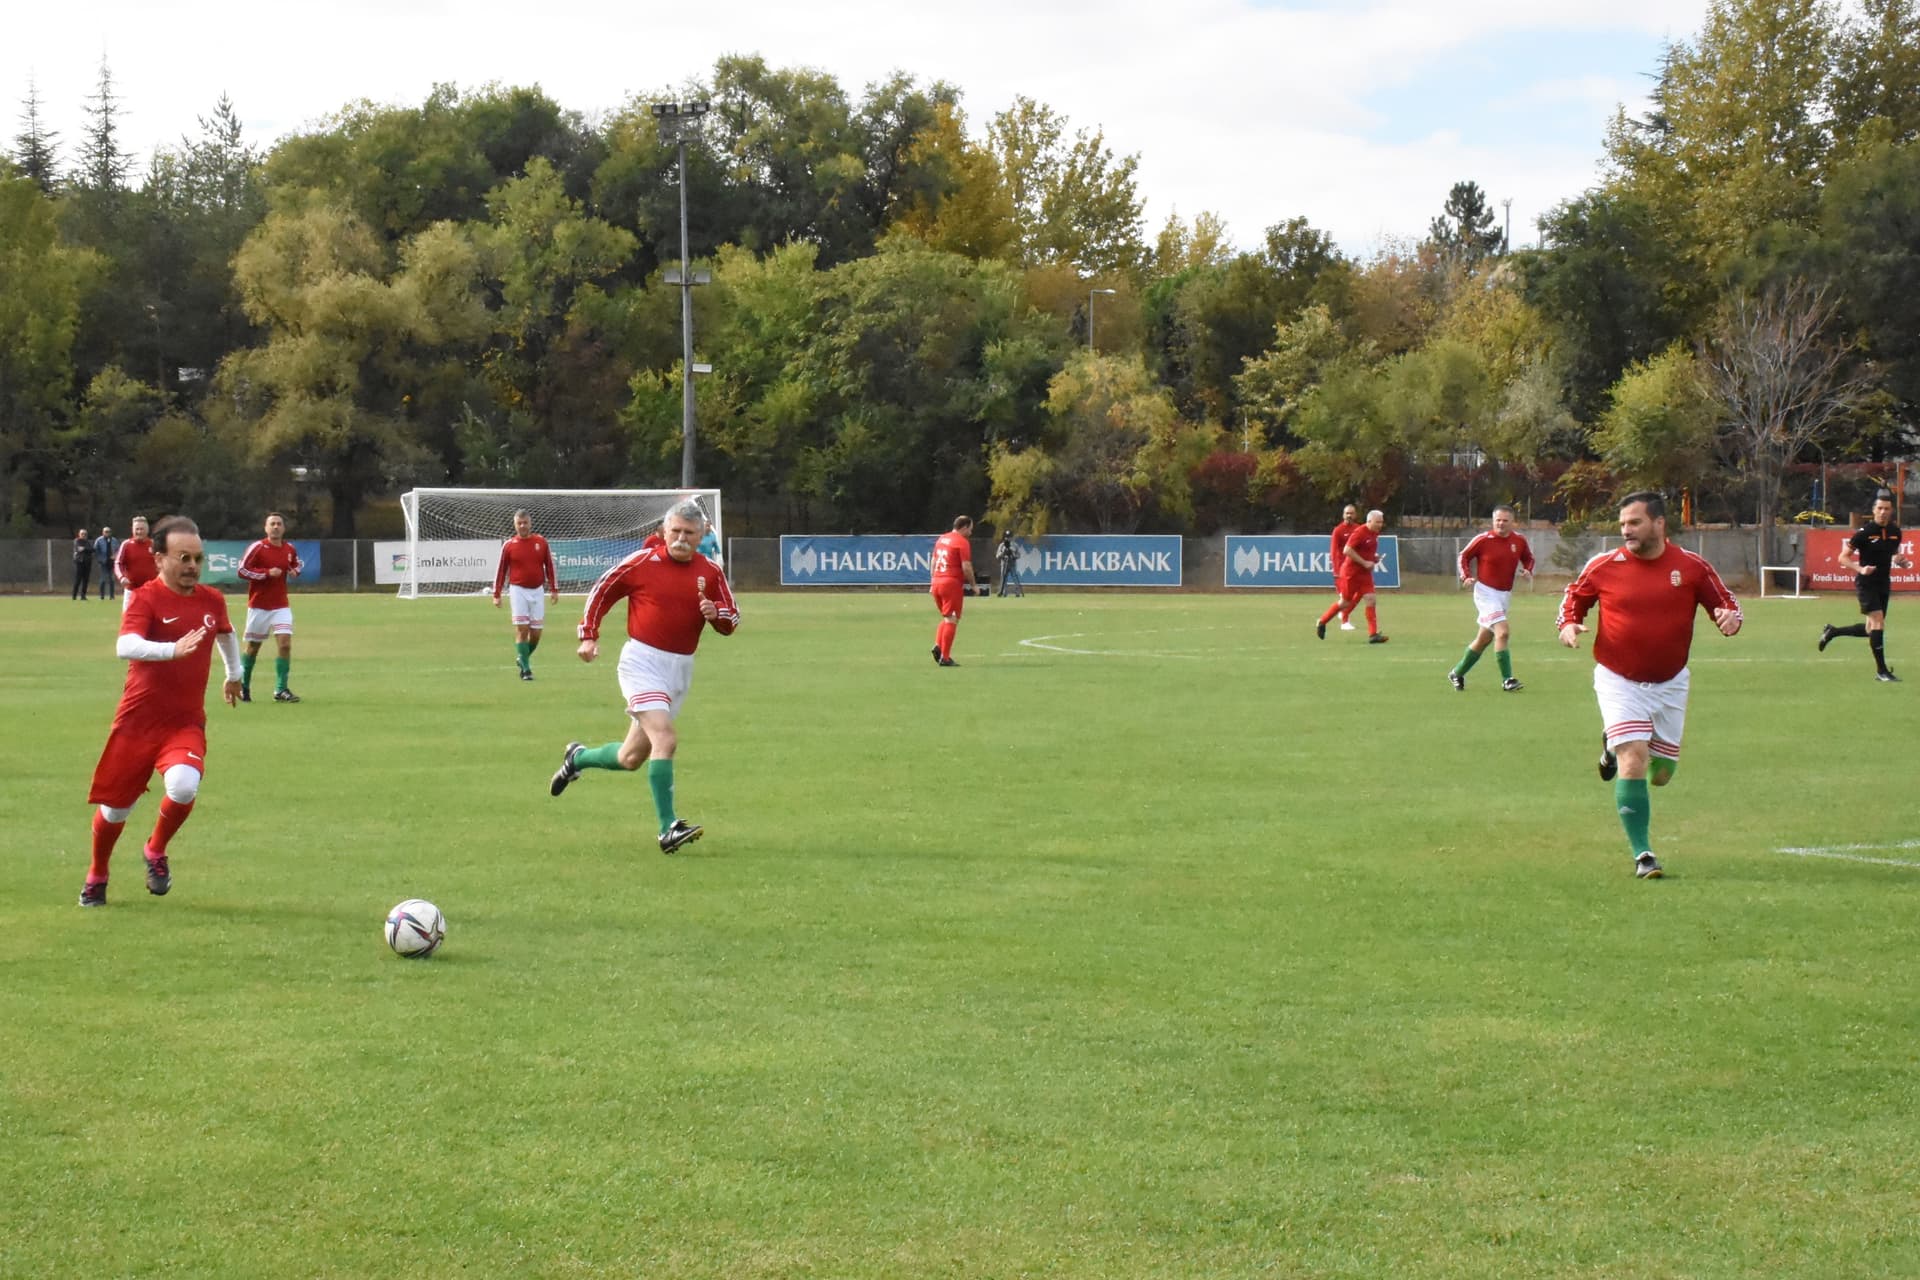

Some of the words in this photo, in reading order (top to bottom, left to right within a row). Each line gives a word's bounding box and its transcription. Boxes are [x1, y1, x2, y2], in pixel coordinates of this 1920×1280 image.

[820, 551, 931, 571] HALKBAN
[1045, 551, 1171, 572] HALKBANK
[1263, 552, 1388, 573] HALKBK
